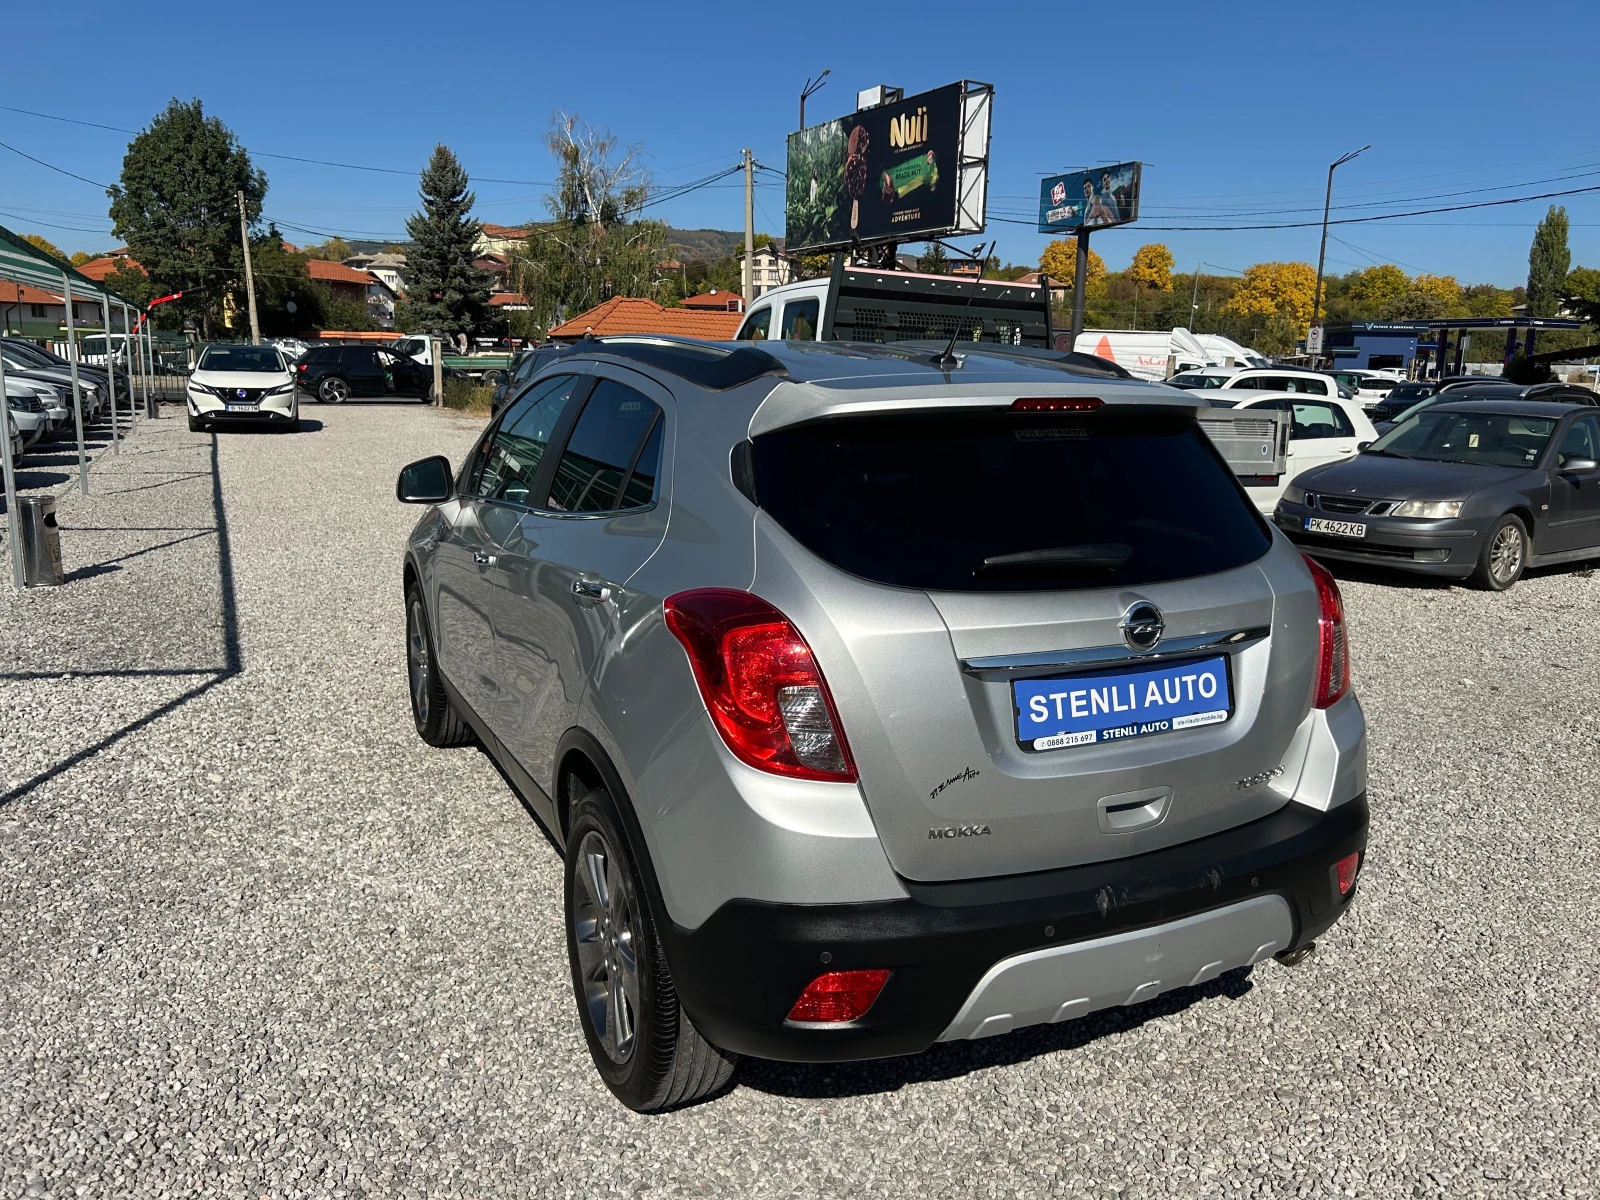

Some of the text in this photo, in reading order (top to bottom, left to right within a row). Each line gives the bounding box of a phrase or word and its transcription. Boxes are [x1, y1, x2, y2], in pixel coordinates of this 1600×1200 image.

[895, 168, 921, 180] BRAZIL NUT
[891, 212, 921, 223] ADVENTURE
[1310, 519, 1322, 531] PK
[1324, 521, 1349, 534] 4622
[1349, 524, 1364, 536] KB
[1029, 672, 1218, 723] STENLI AUTO
[1102, 721, 1169, 739] STENLI AUTO
[1047, 733, 1093, 747] 0888 215 697
[928, 824, 992, 839] MOKKA
